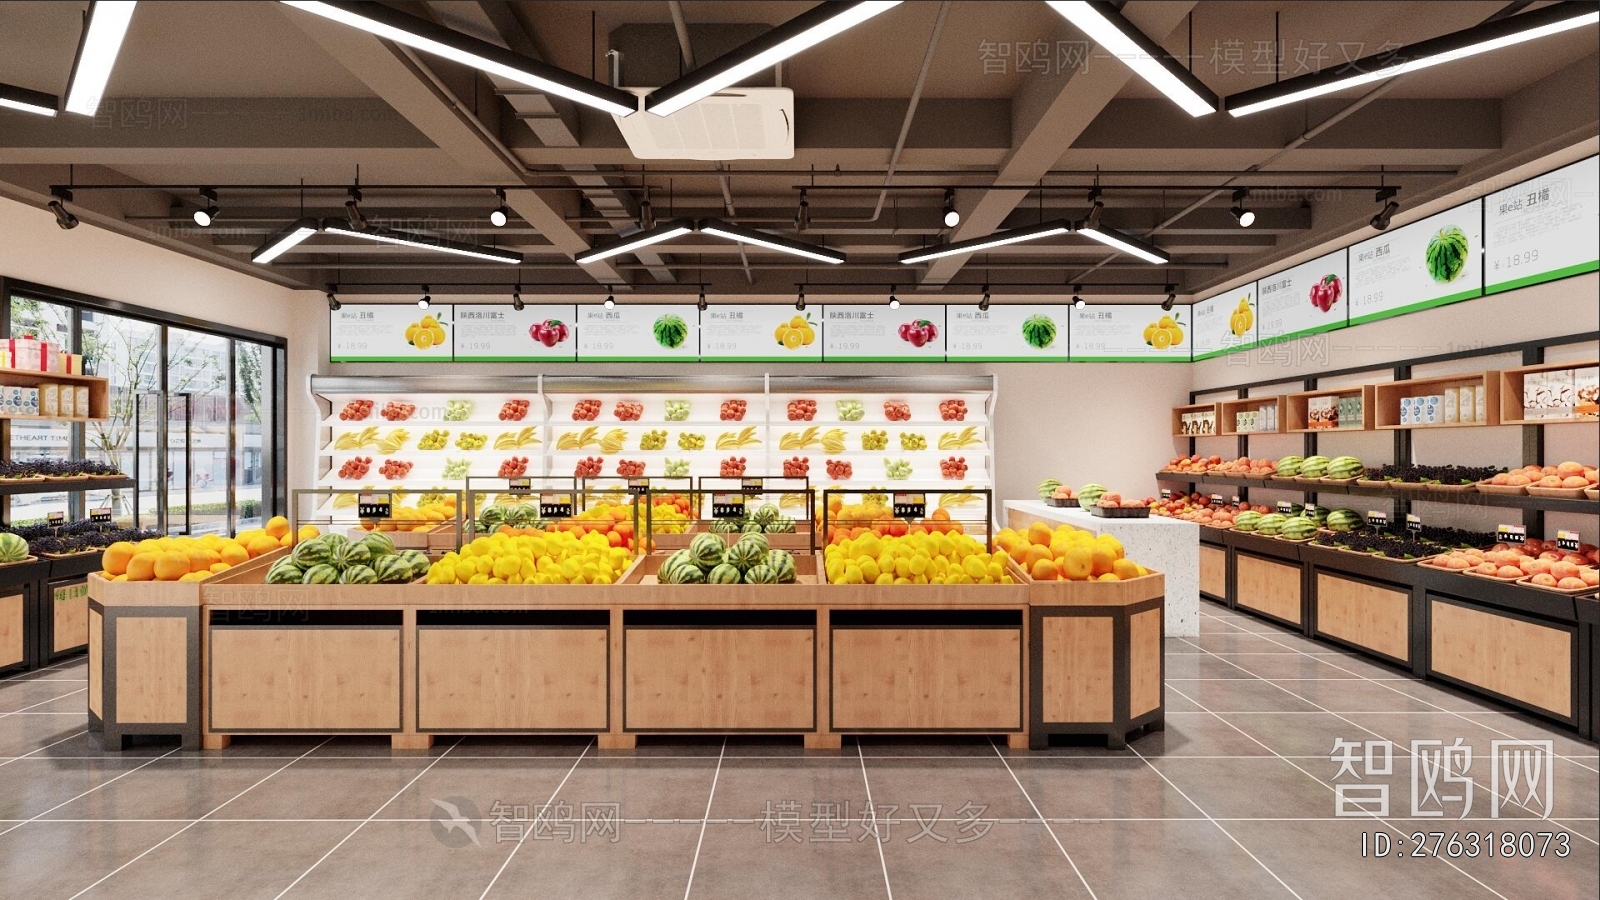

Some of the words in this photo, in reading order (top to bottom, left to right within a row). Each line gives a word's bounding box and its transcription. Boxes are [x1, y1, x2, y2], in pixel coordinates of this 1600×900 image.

[1375, 243, 1391, 257] 西瓜
[460, 311, 505, 320] 陕西洛川富士
[829, 311, 874, 320] 陕西洛川富士
